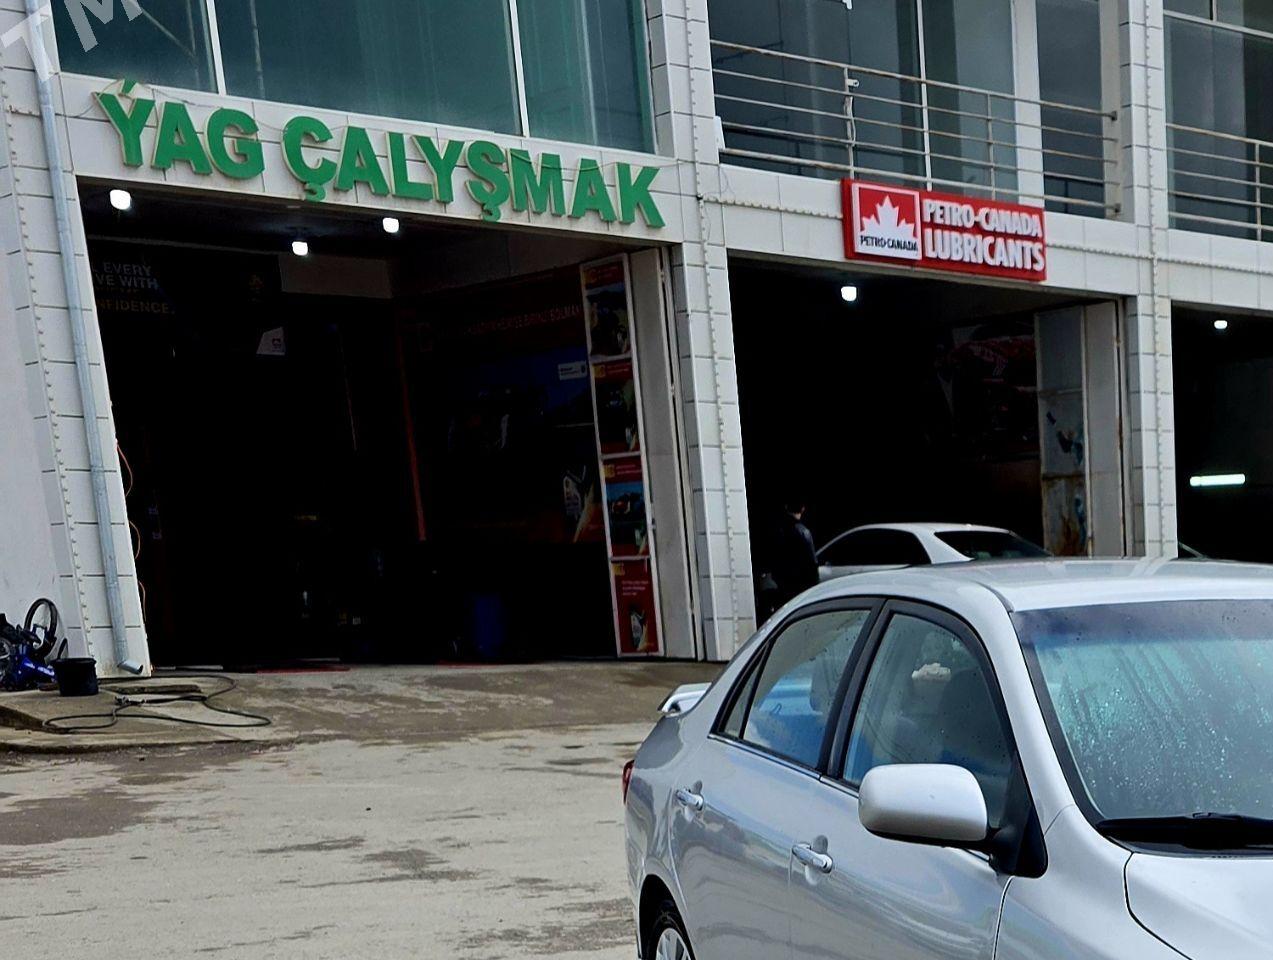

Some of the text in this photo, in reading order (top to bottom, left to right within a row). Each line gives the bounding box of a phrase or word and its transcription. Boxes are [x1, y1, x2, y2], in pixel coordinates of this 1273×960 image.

[98, 81, 667, 229] ÝAG ÇALYŞMAK
[922, 198, 1043, 238] PETRO-CANADA
[923, 228, 1045, 272] LUBRICANTS
